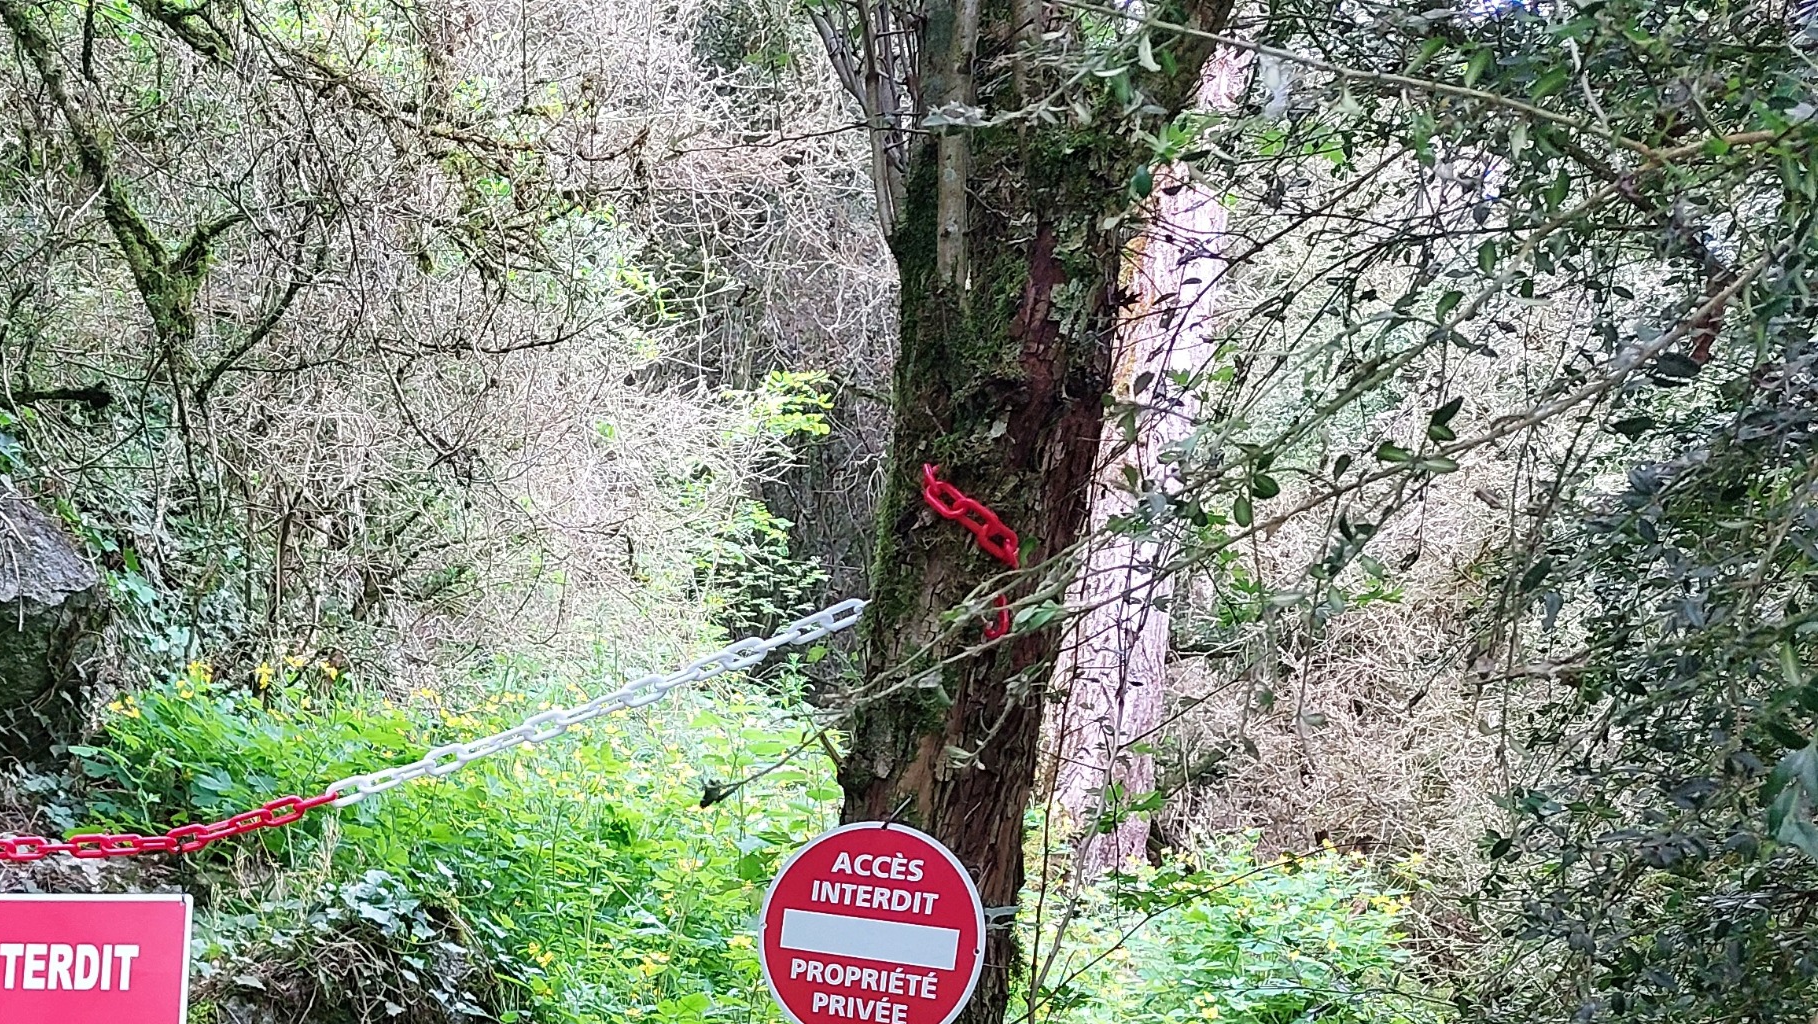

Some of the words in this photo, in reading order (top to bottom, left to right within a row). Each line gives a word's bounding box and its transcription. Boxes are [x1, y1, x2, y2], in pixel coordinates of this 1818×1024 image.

[831, 852, 925, 882] ACCÈS
[811, 879, 939, 915] INTERDIT
[790, 957, 938, 1000] PROPRIÉTÉ
